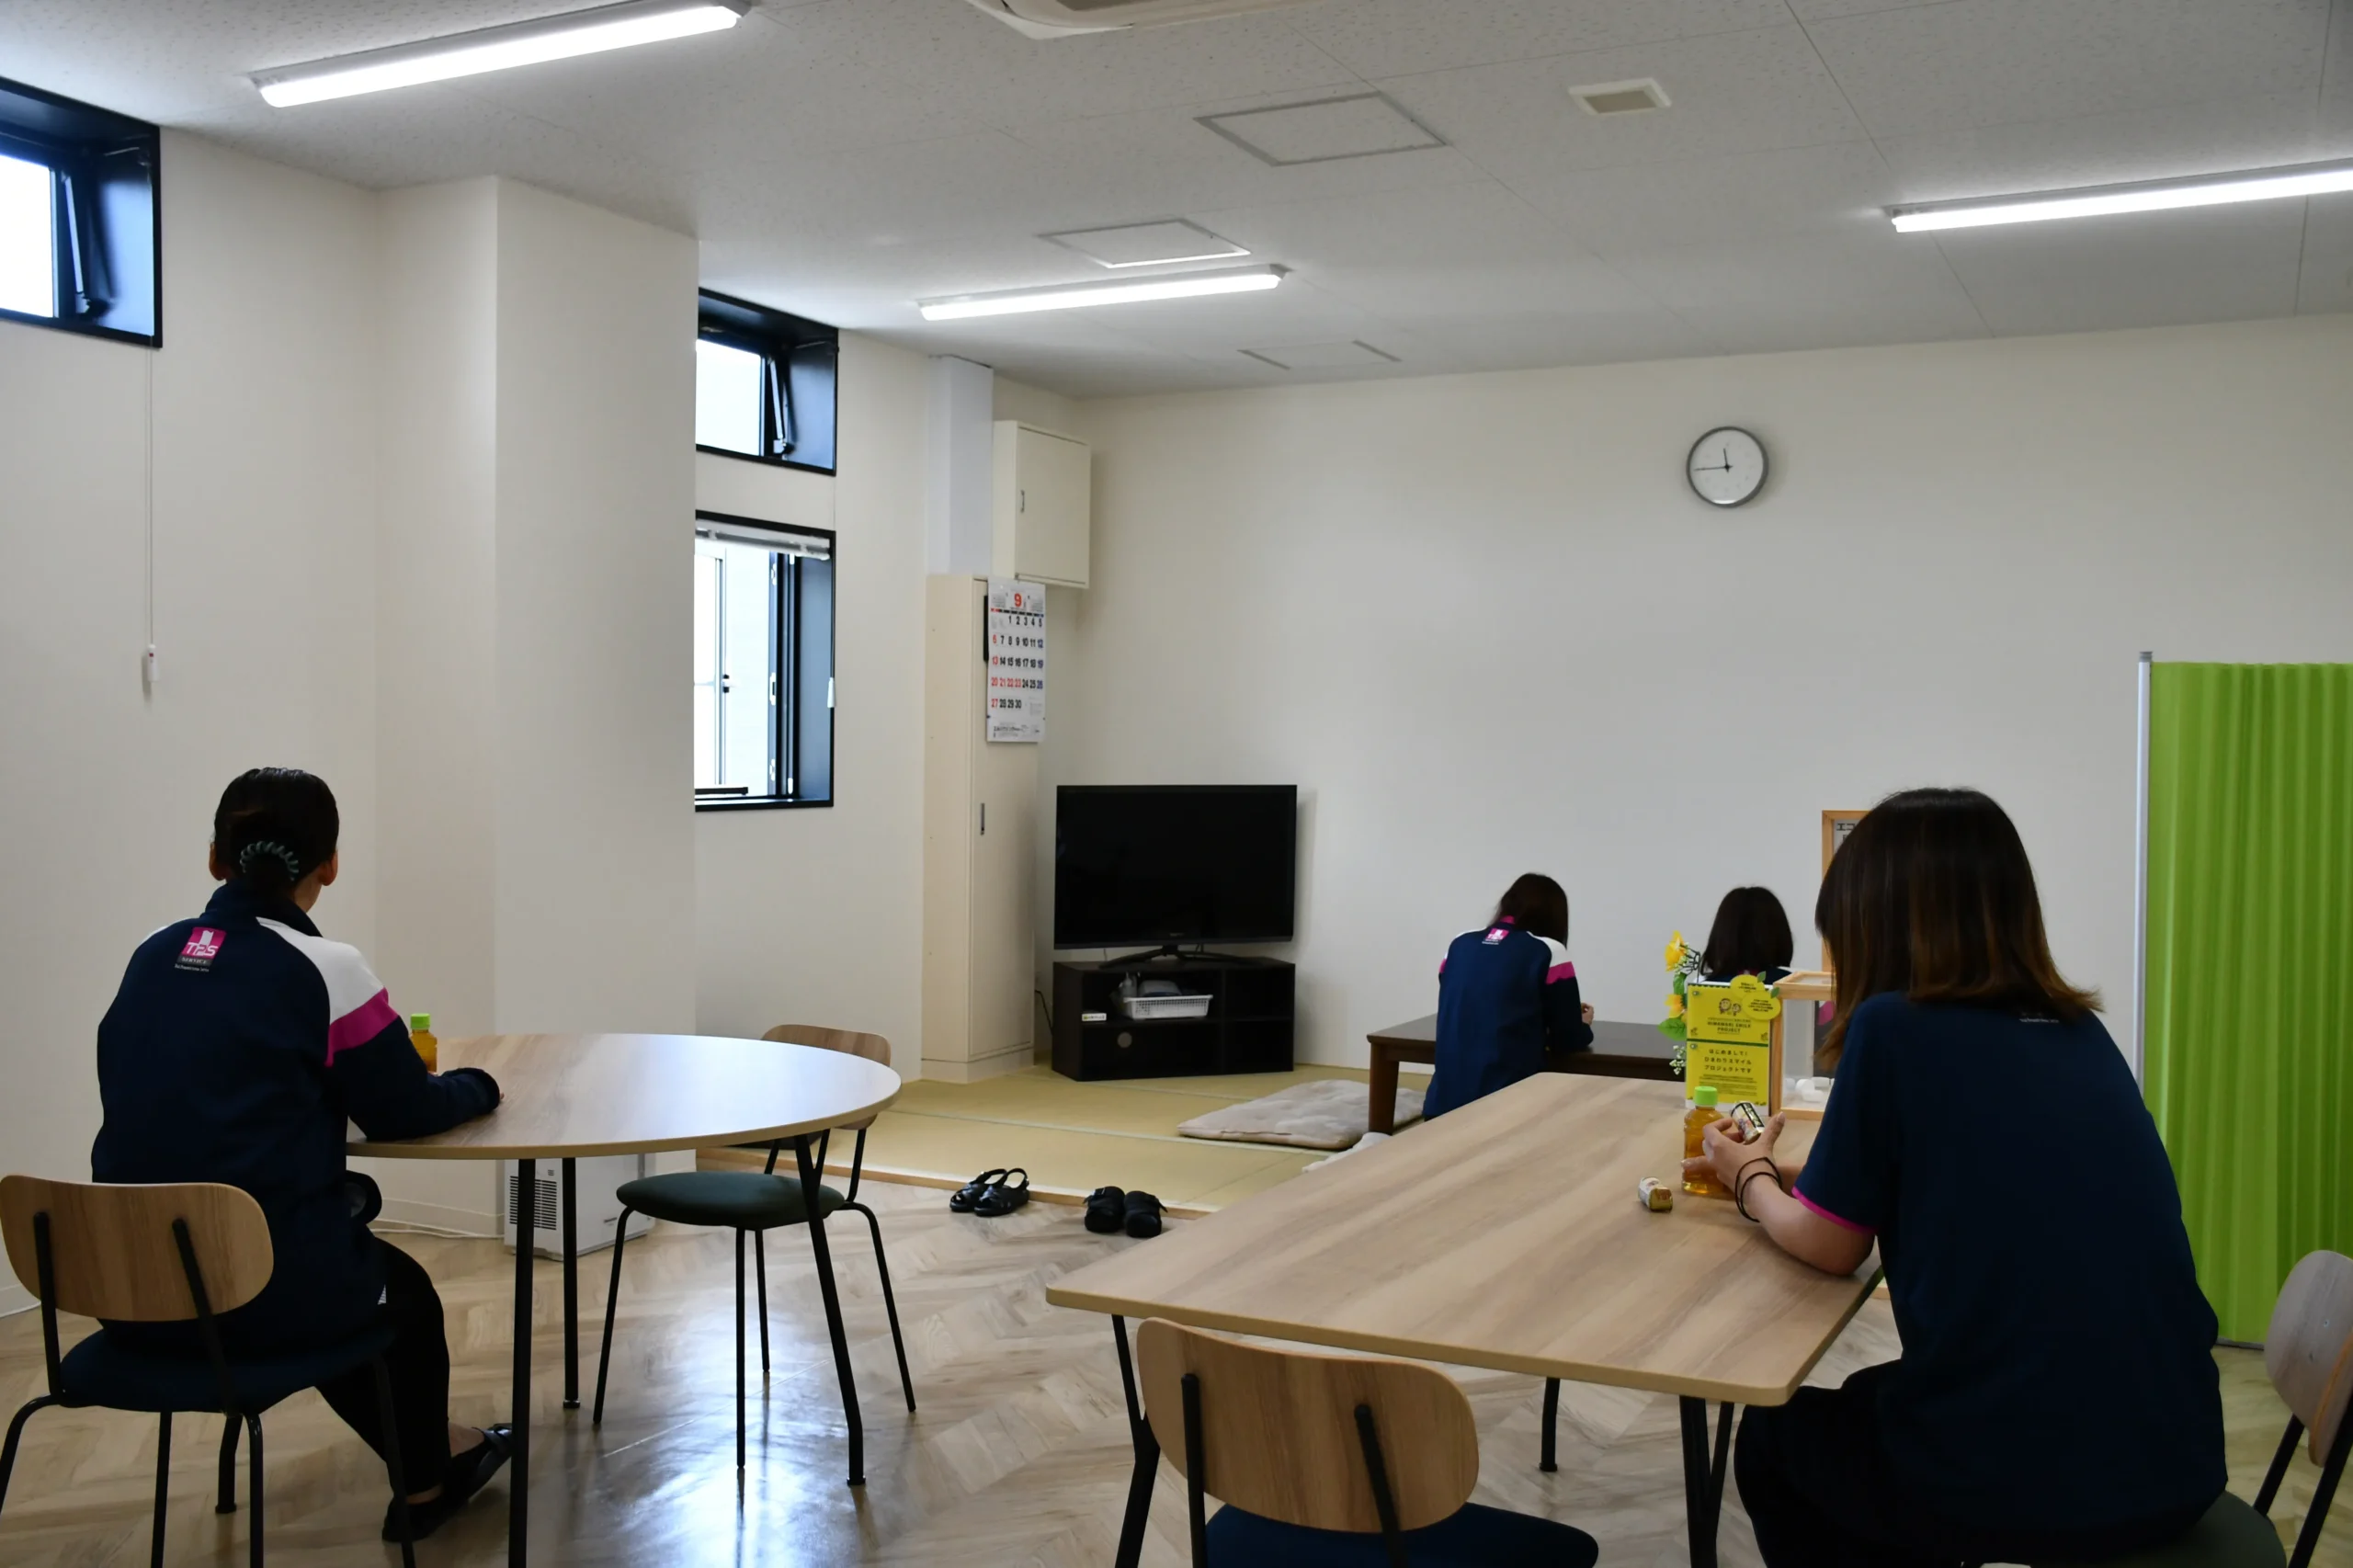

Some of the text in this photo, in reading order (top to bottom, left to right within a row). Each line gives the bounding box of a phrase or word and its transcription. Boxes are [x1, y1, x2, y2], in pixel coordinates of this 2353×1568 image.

[1014, 593, 1022, 608] 9
[1008, 615, 1042, 627] 1 2 3 4 5
[993, 634, 1043, 648] 6 7 8 9 10 11 12
[992, 656, 998, 665] 13
[1000, 657, 1006, 665] 14
[1008, 657, 1013, 666] 15
[1015, 658, 1021, 667] 16
[1023, 658, 1028, 667] 17
[1030, 659, 1036, 668] 18
[991, 677, 1043, 689] 20 21 22 23 24 25 26
[991, 698, 998, 707] 27
[1000, 699, 1006, 708] 28
[1007, 699, 1014, 708] 29
[1015, 699, 1022, 709] 30
[1704, 1056, 1752, 1065] ひまわりスマイル
[1705, 1065, 1751, 1074] プロジェクトです
